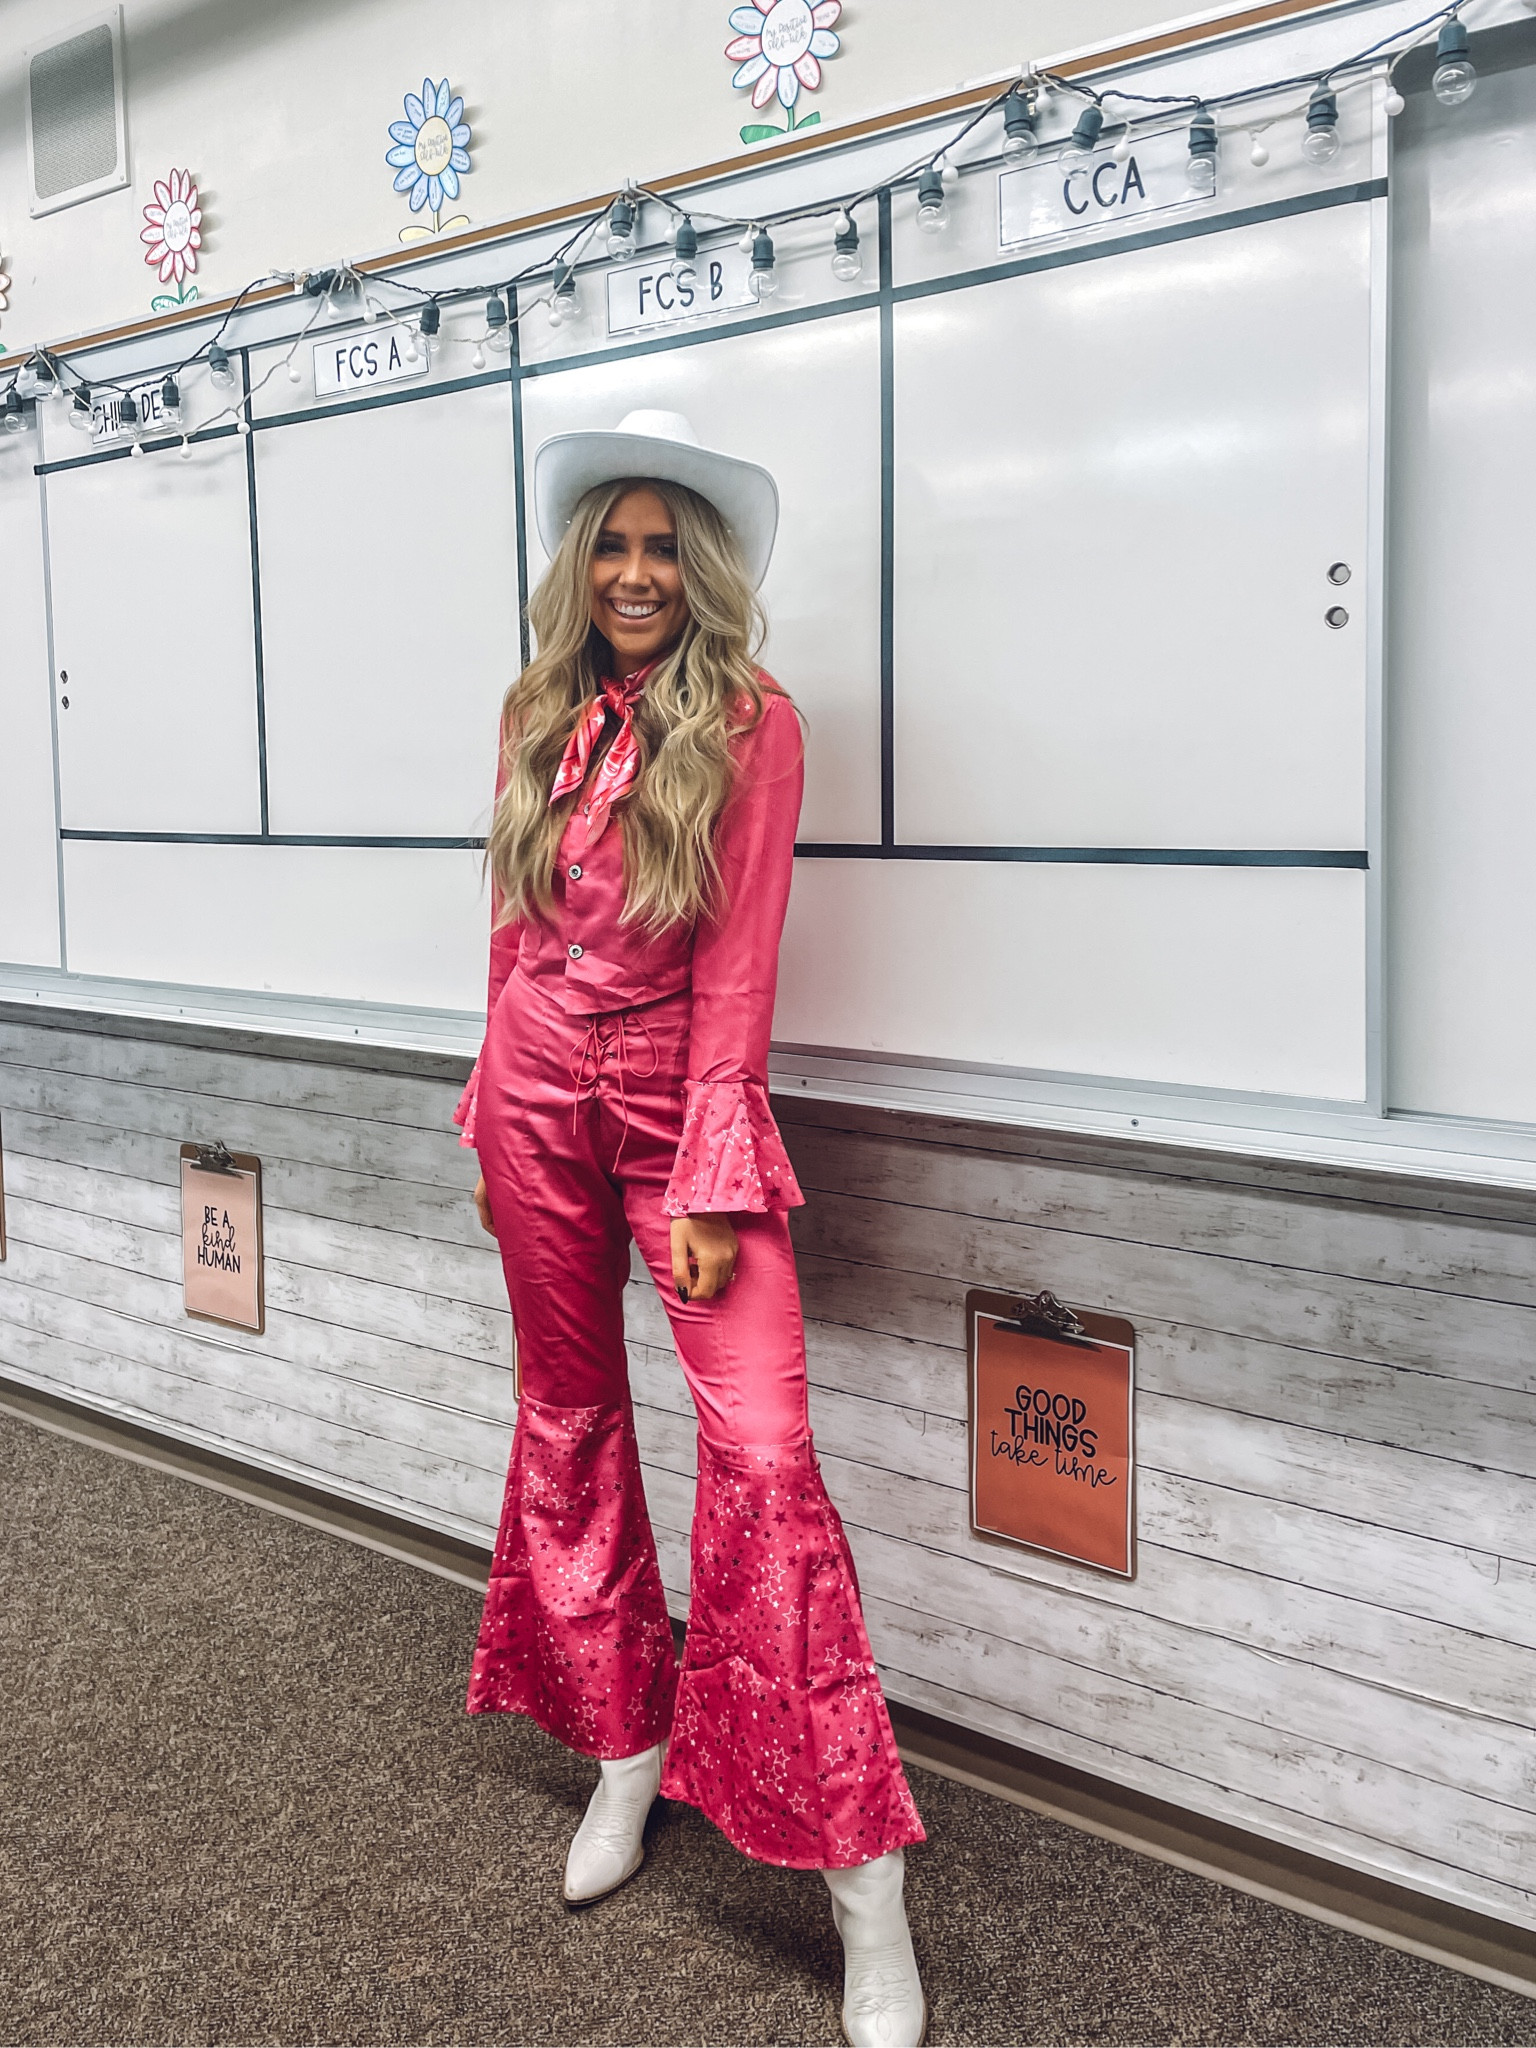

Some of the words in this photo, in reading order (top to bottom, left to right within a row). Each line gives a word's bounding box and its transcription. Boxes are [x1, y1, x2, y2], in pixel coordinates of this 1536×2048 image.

[1063, 156, 1146, 215] CCA
[639, 267, 697, 316] FCS
[709, 261, 723, 300] B
[335, 342, 379, 382] FCS
[388, 336, 402, 371] A
[141, 389, 165, 423] DE
[201, 1222, 236, 1253] kind
[204, 1205, 219, 1227] BE
[222, 1210, 230, 1228] A
[197, 1244, 241, 1274] HUMAN
[1015, 1384, 1088, 1426] GOOD
[1003, 1407, 1100, 1459] THINGS
[990, 1429, 1050, 1467] take
[1054, 1447, 1118, 1489] time
